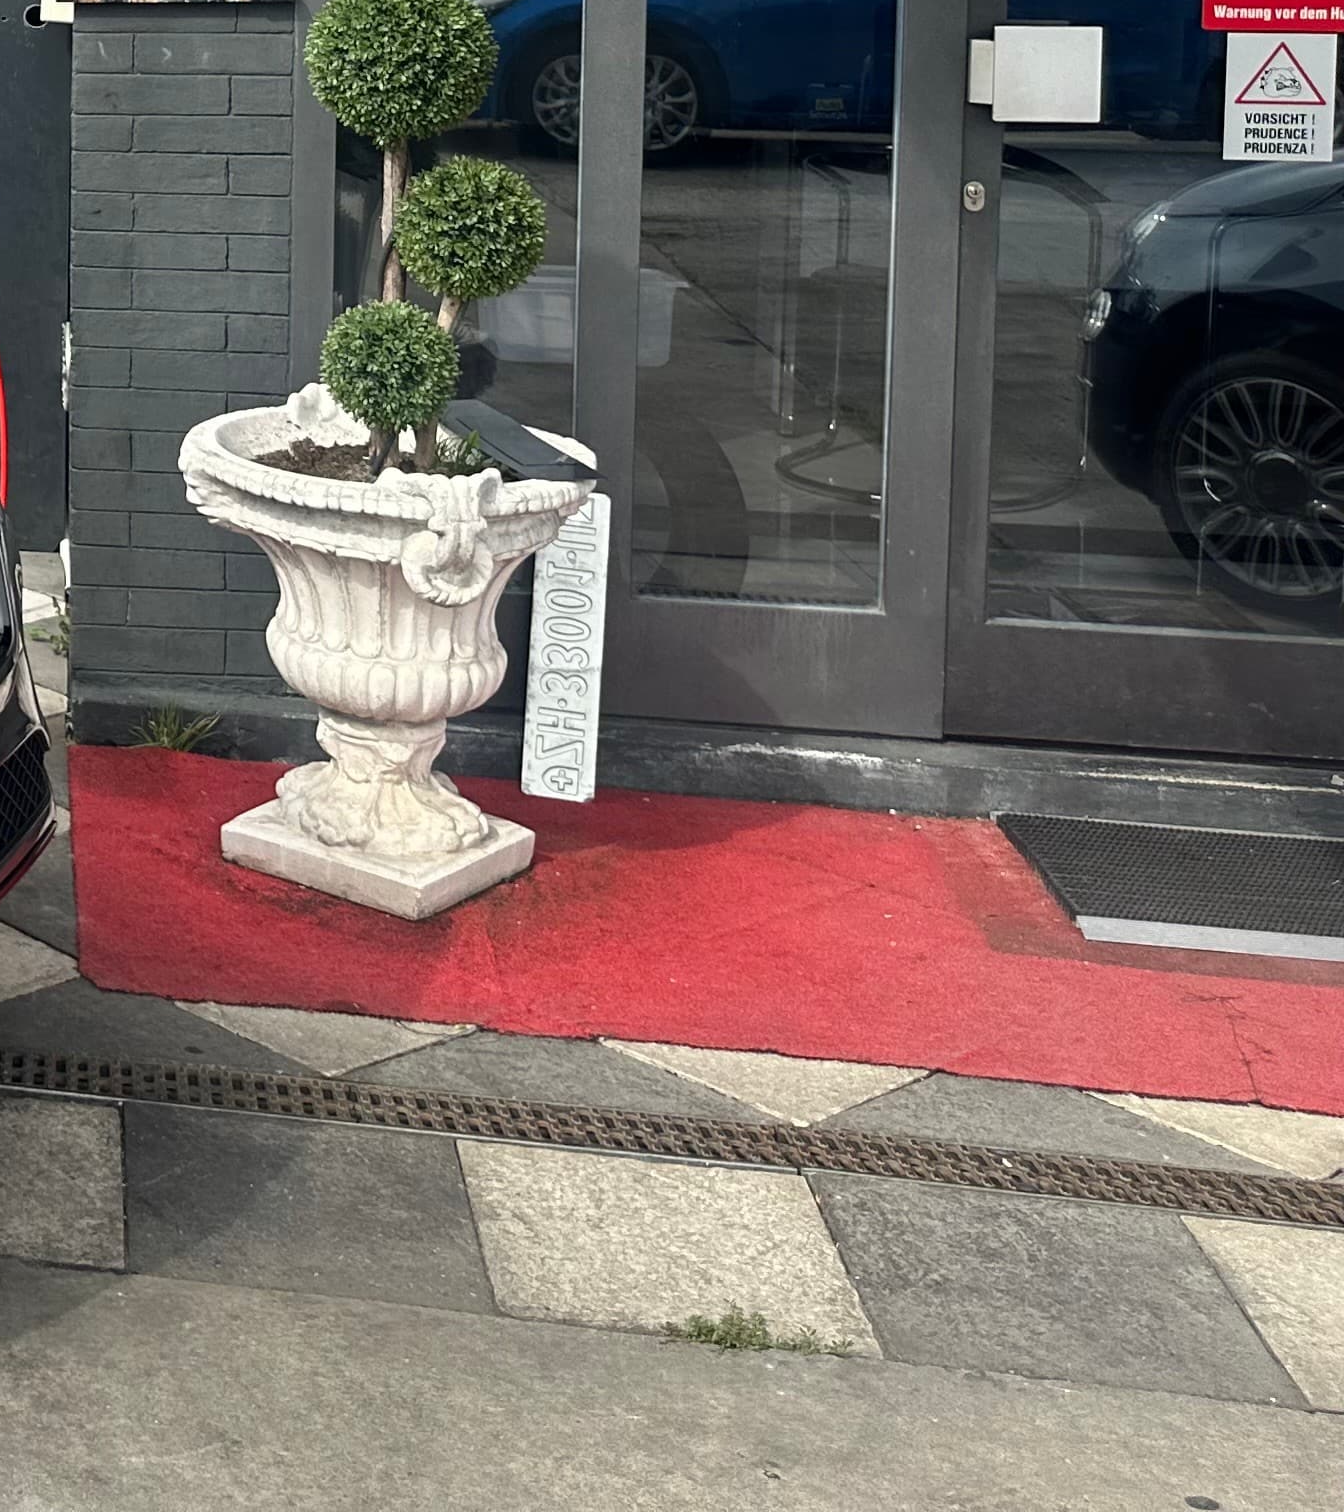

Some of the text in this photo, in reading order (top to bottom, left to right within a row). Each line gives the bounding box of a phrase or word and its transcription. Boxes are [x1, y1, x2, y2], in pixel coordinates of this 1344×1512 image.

[1213, 5, 1272, 21] Warnung
[1275, 8, 1296, 19] vor
[1299, 6, 1327, 20] dem
[1244, 113, 1307, 125] VORSICHT
[1243, 127, 1308, 140] PRUDENCE
[1243, 142, 1307, 154] PRUDENZA
